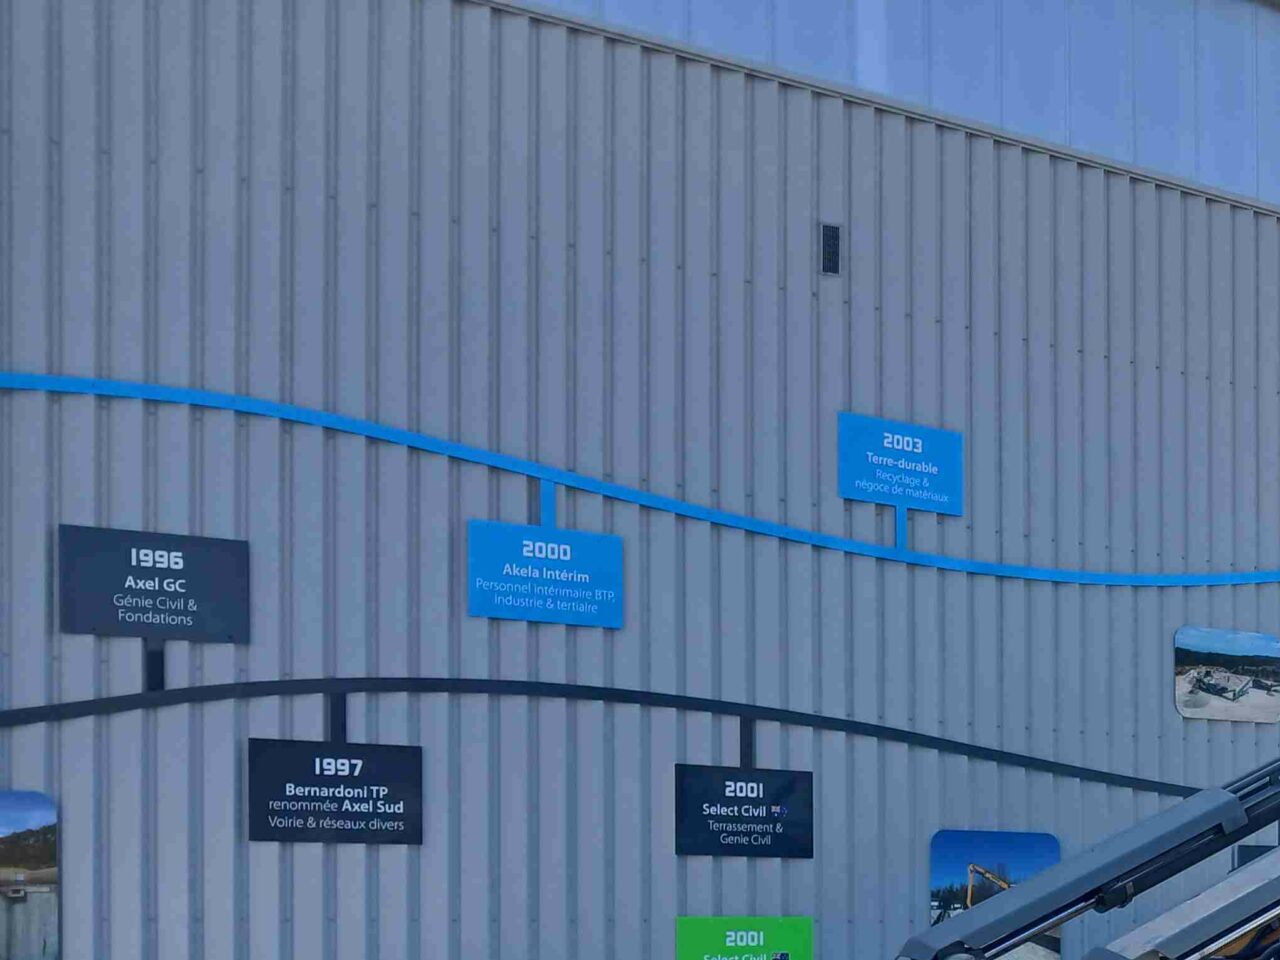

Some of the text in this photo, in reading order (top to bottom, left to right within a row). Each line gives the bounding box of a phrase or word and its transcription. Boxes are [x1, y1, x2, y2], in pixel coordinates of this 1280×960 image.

[883, 432, 923, 453] 2003
[866, 451, 938, 475] Terre-durable
[875, 468, 930, 487] Recyclage &
[855, 479, 949, 502] négoce de matériaux
[131, 548, 184, 569] 1996
[522, 540, 571, 561] 2000
[502, 563, 590, 583] Akela Intérim
[124, 575, 186, 592] Axel GC
[475, 577, 532, 594] Personnel
[534, 583, 593, 600] intérimaire
[113, 593, 198, 611] Génie Civil &
[546, 597, 555, 609] &
[557, 599, 598, 614] tertiaire
[118, 609, 193, 626] Fondations
[314, 757, 363, 776] 1997
[285, 783, 388, 799] Bernardoni TP
[724, 781, 764, 798] 2001
[268, 799, 404, 814] renommée Axel Sud
[702, 803, 766, 817] Select Civil
[268, 815, 405, 831] Voirie & réseaux divers
[707, 820, 784, 833] Terrassement &
[750, 834, 771, 845] Civil
[725, 930, 764, 947] 2001
